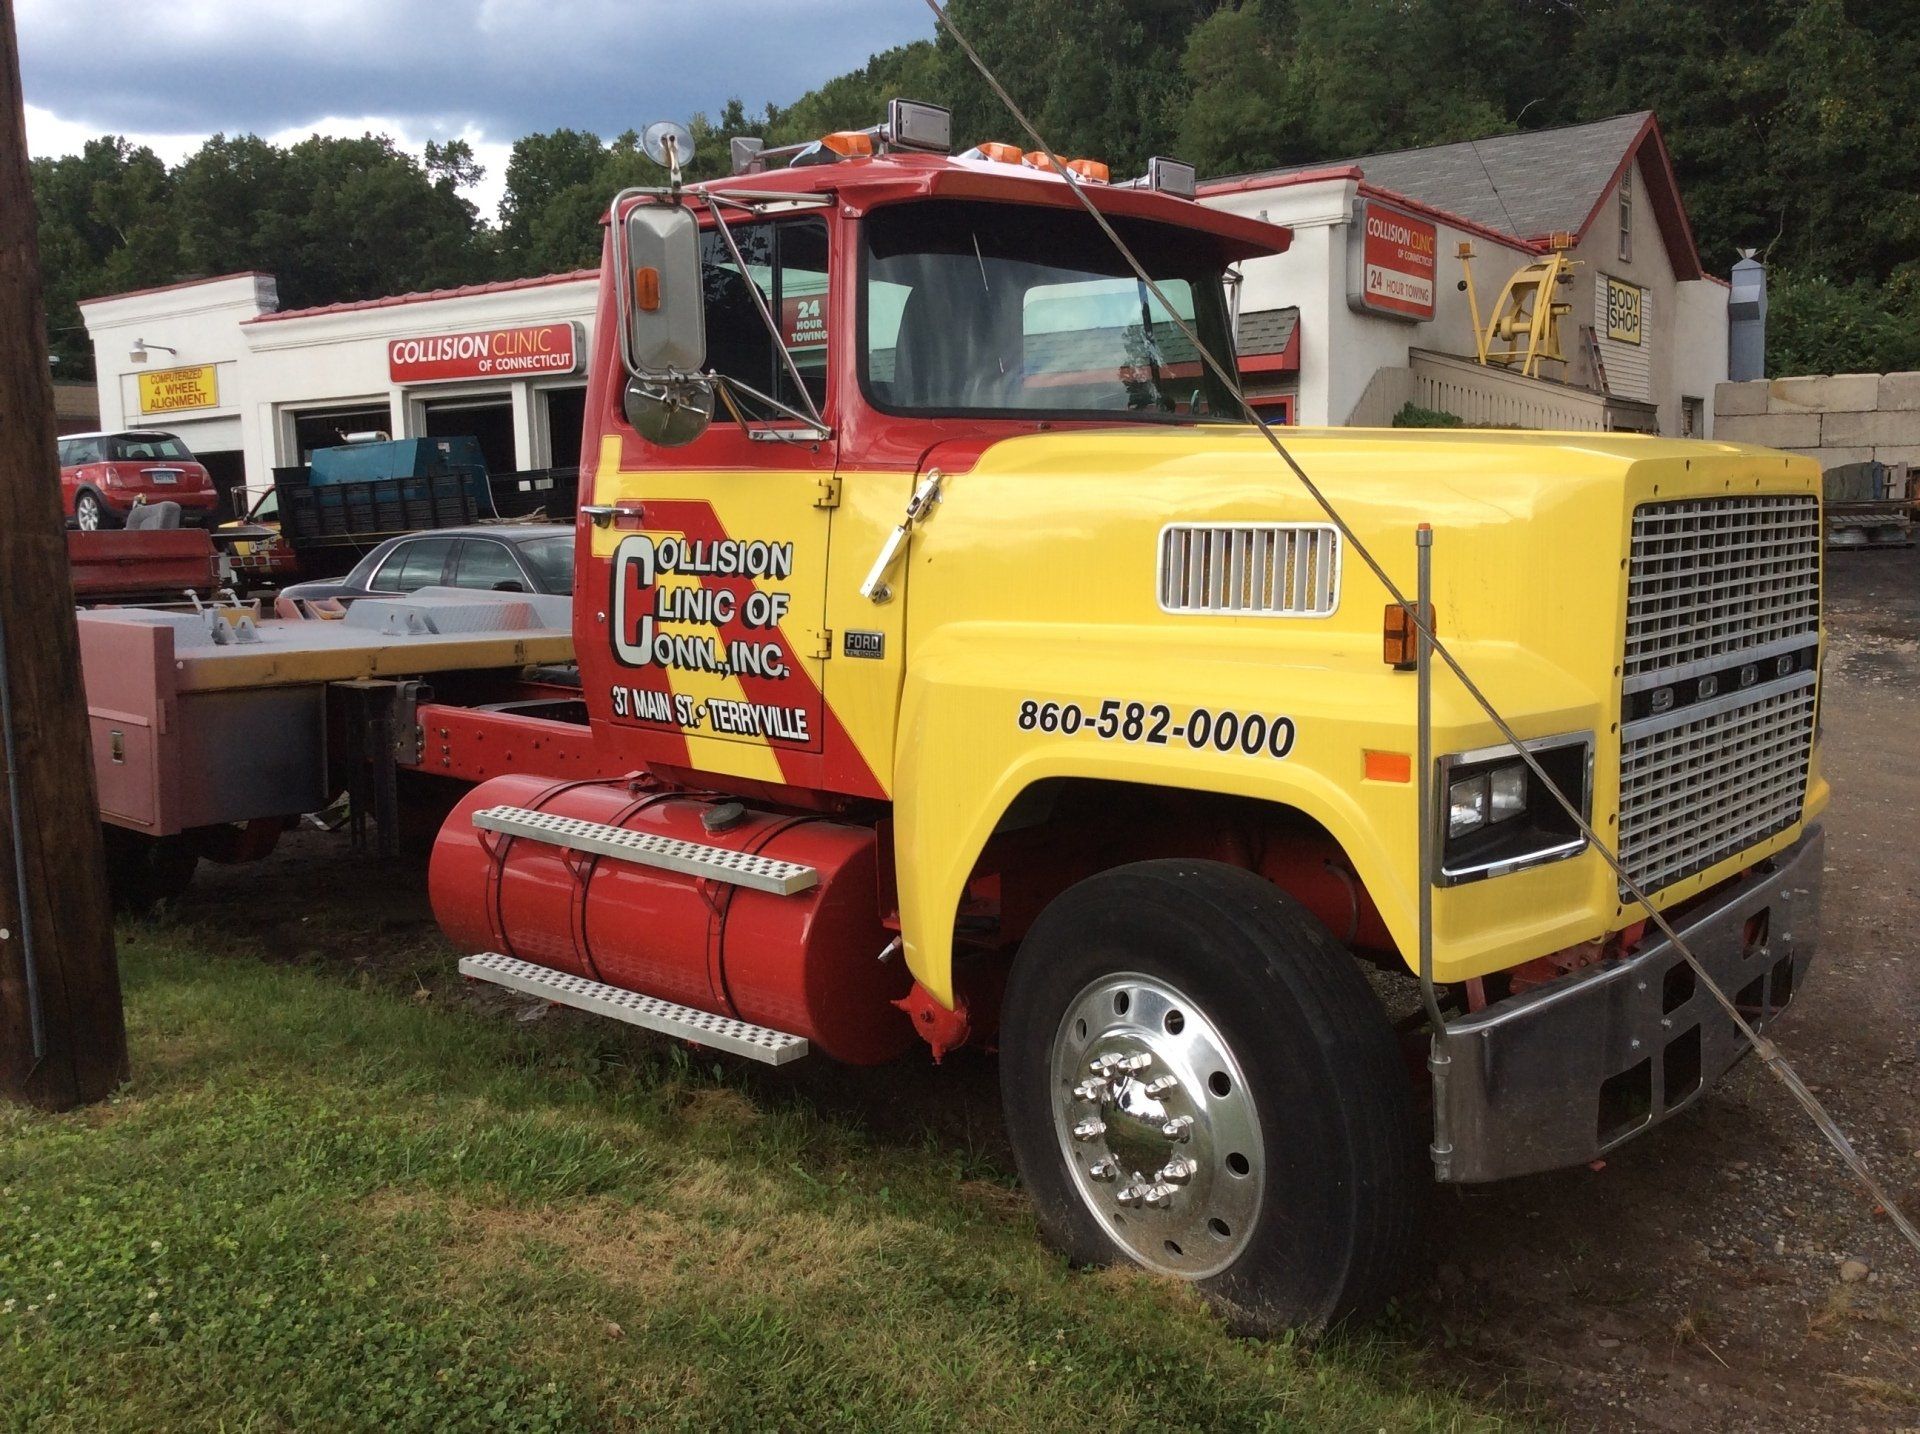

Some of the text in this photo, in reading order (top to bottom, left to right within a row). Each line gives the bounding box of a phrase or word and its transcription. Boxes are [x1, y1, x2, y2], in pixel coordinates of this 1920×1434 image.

[1367, 217, 1434, 254] COLLISION CLINIC
[1397, 248, 1405, 258] OF
[1371, 270, 1429, 302] 24 HOUR TOWING
[1609, 285, 1639, 313] BODY
[797, 300, 820, 319] 24
[796, 319, 822, 330] HOUR
[1609, 307, 1639, 333] SHOP
[791, 330, 828, 342] TOWING
[392, 328, 552, 365] COLLISION CLINIC
[478, 353, 571, 372] OF CONNECTICUT
[150, 368, 203, 384] COMPUTERIZED
[154, 381, 201, 395] 4 WHEEL
[150, 393, 207, 409] ALIGNMENT
[745, 591, 791, 627] OF
[847, 634, 879, 650] FORD
[612, 685, 629, 717] 37
[632, 688, 673, 722] MAIN
[1017, 699, 1297, 759] 860-582-0000
